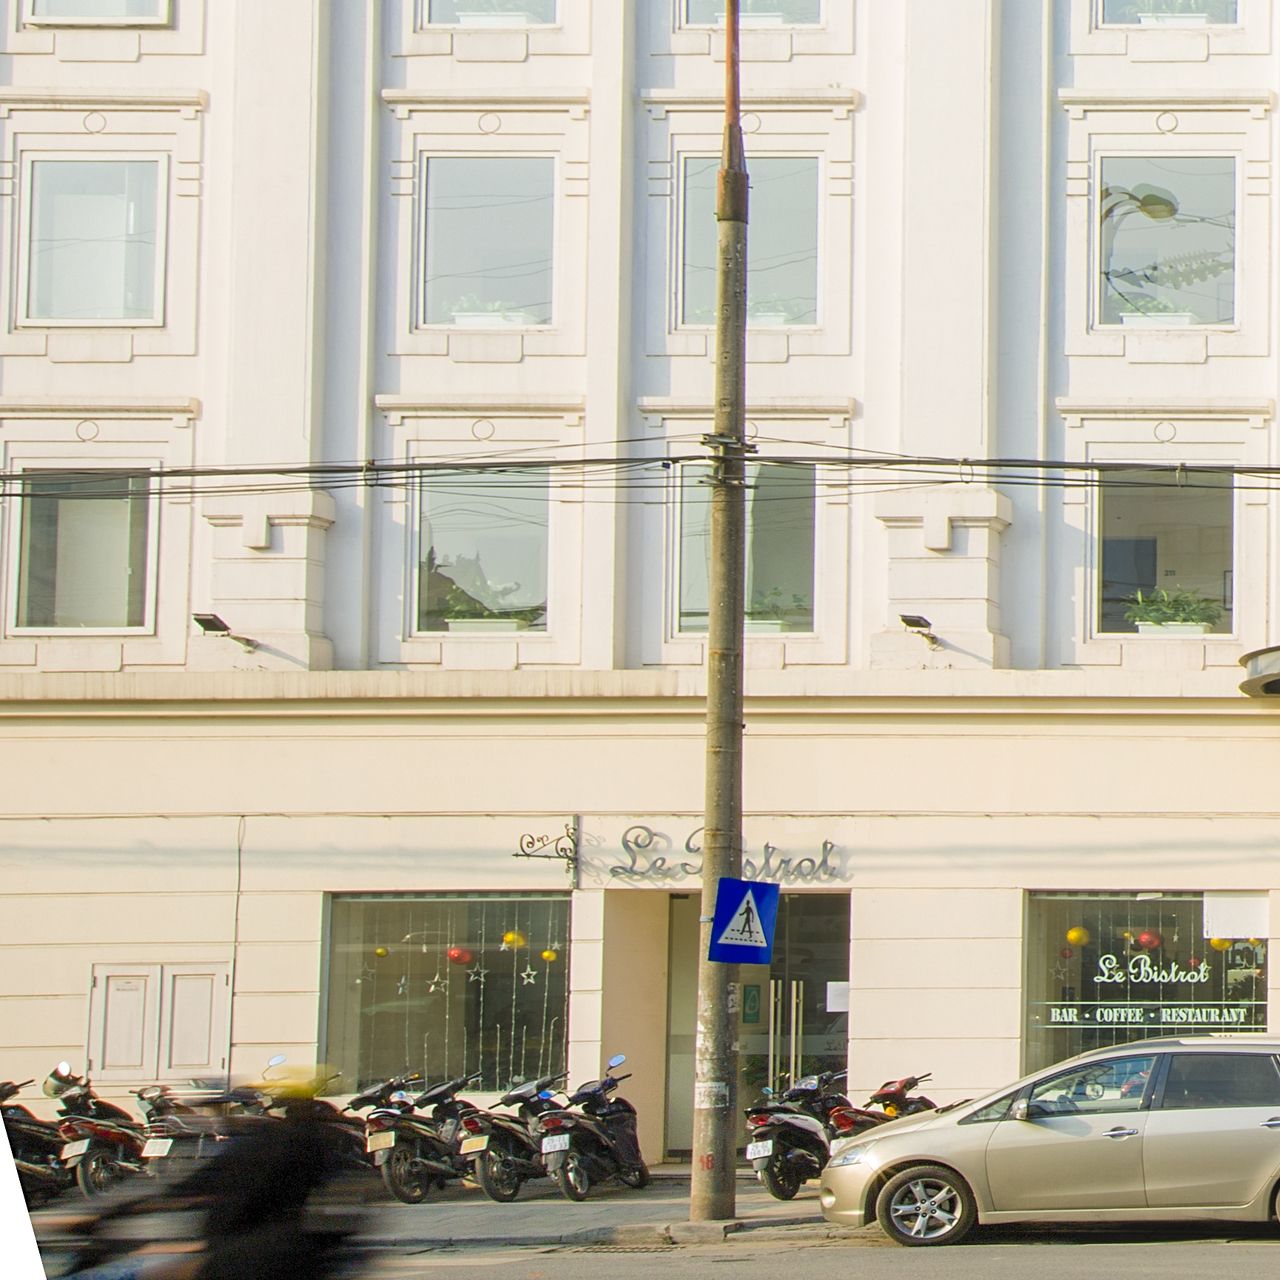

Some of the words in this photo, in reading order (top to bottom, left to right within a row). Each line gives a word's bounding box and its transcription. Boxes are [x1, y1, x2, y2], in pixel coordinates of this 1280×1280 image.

[609, 825, 670, 877] Le
[1093, 954, 1125, 983] Le
[1129, 954, 1209, 983] Bistrot
[1050, 1008, 1077, 1022] BAR
[1096, 1008, 1143, 1022] COFFEE
[1162, 1008, 1246, 1022] RESTAURANT
